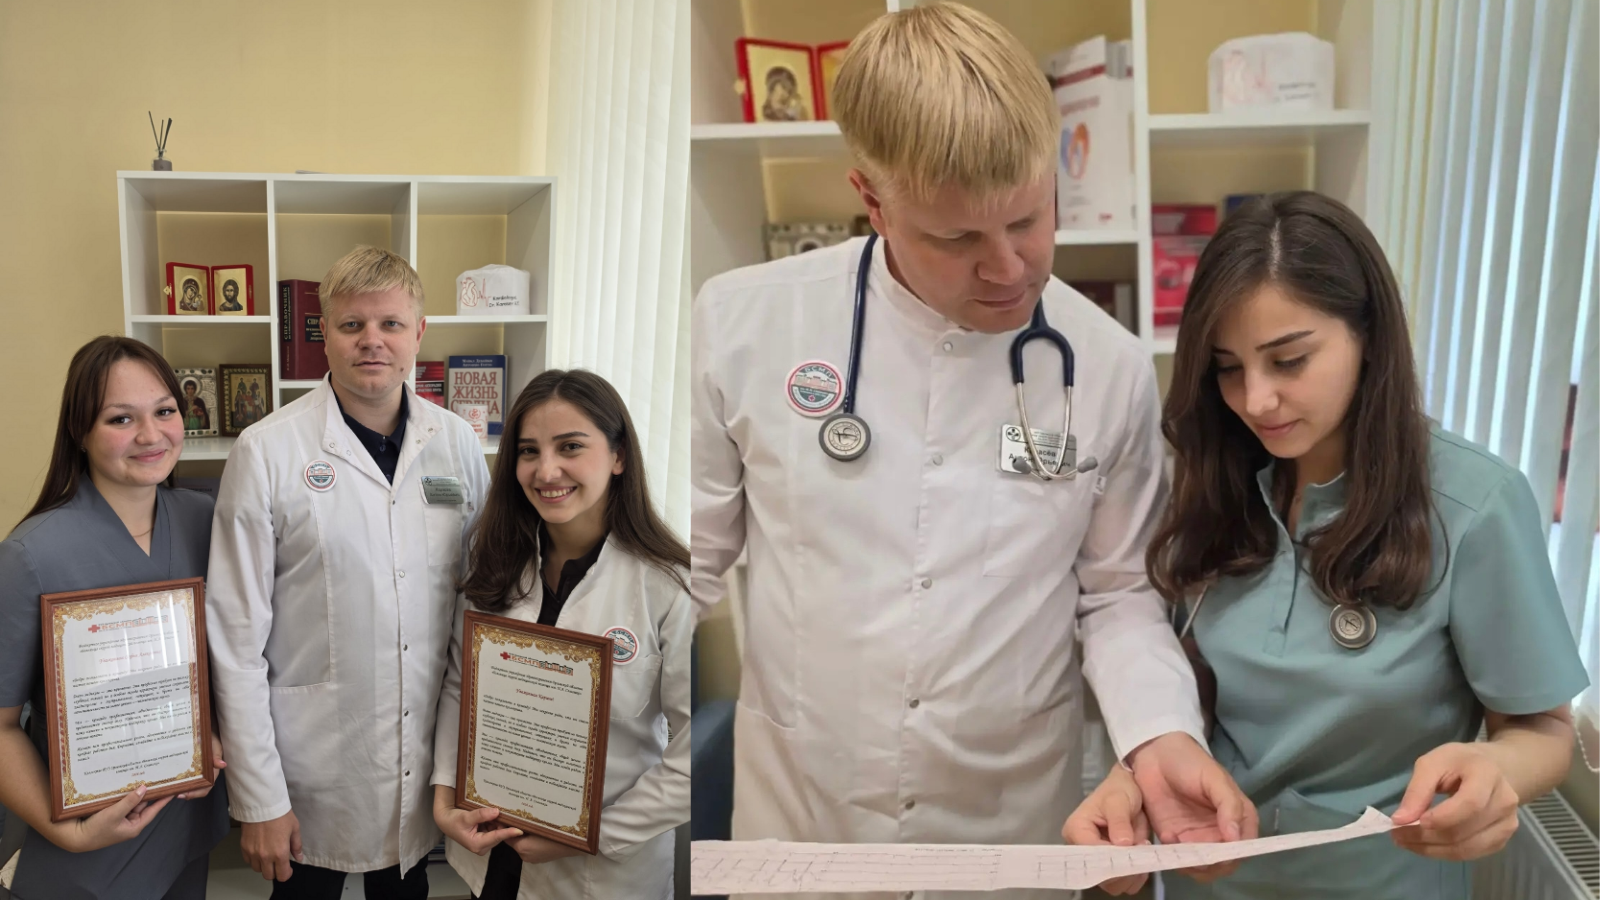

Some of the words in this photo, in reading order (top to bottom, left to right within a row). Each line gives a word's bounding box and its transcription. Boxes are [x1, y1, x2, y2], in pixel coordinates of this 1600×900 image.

[454, 371, 497, 385] НОВАЯ
[452, 386, 498, 399] ЖИЗНЬ
[450, 399, 500, 416] СЦА
